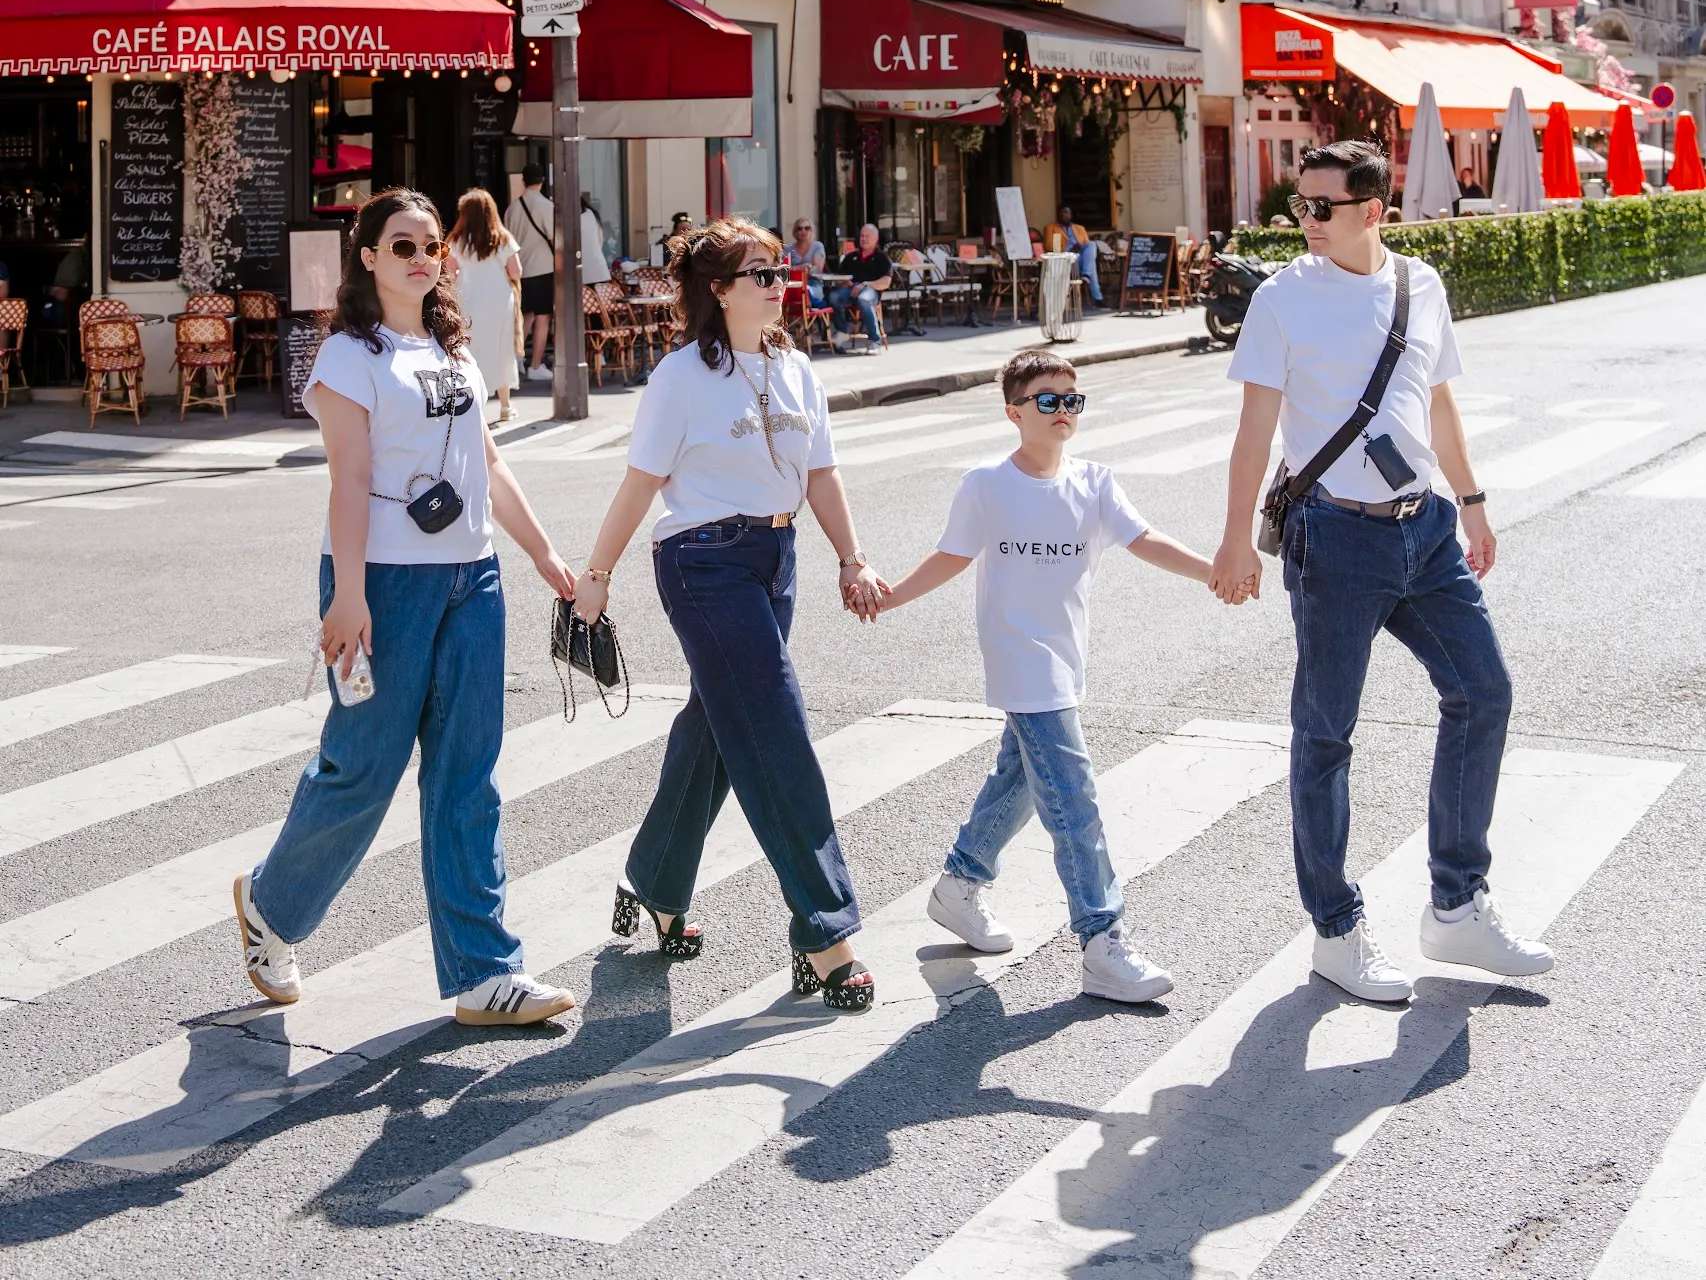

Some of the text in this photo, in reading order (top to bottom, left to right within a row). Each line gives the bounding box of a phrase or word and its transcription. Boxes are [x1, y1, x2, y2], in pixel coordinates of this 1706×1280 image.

[526, 4, 549, 14] PETITS
[92, 21, 390, 54] CAFÉ PALAIS ROYAL
[873, 34, 959, 72] CAFE
[131, 84, 160, 108] Café
[115, 97, 177, 115] Palais Royal
[126, 163, 166, 176] SNAILS
[123, 191, 173, 205] BURGERS
